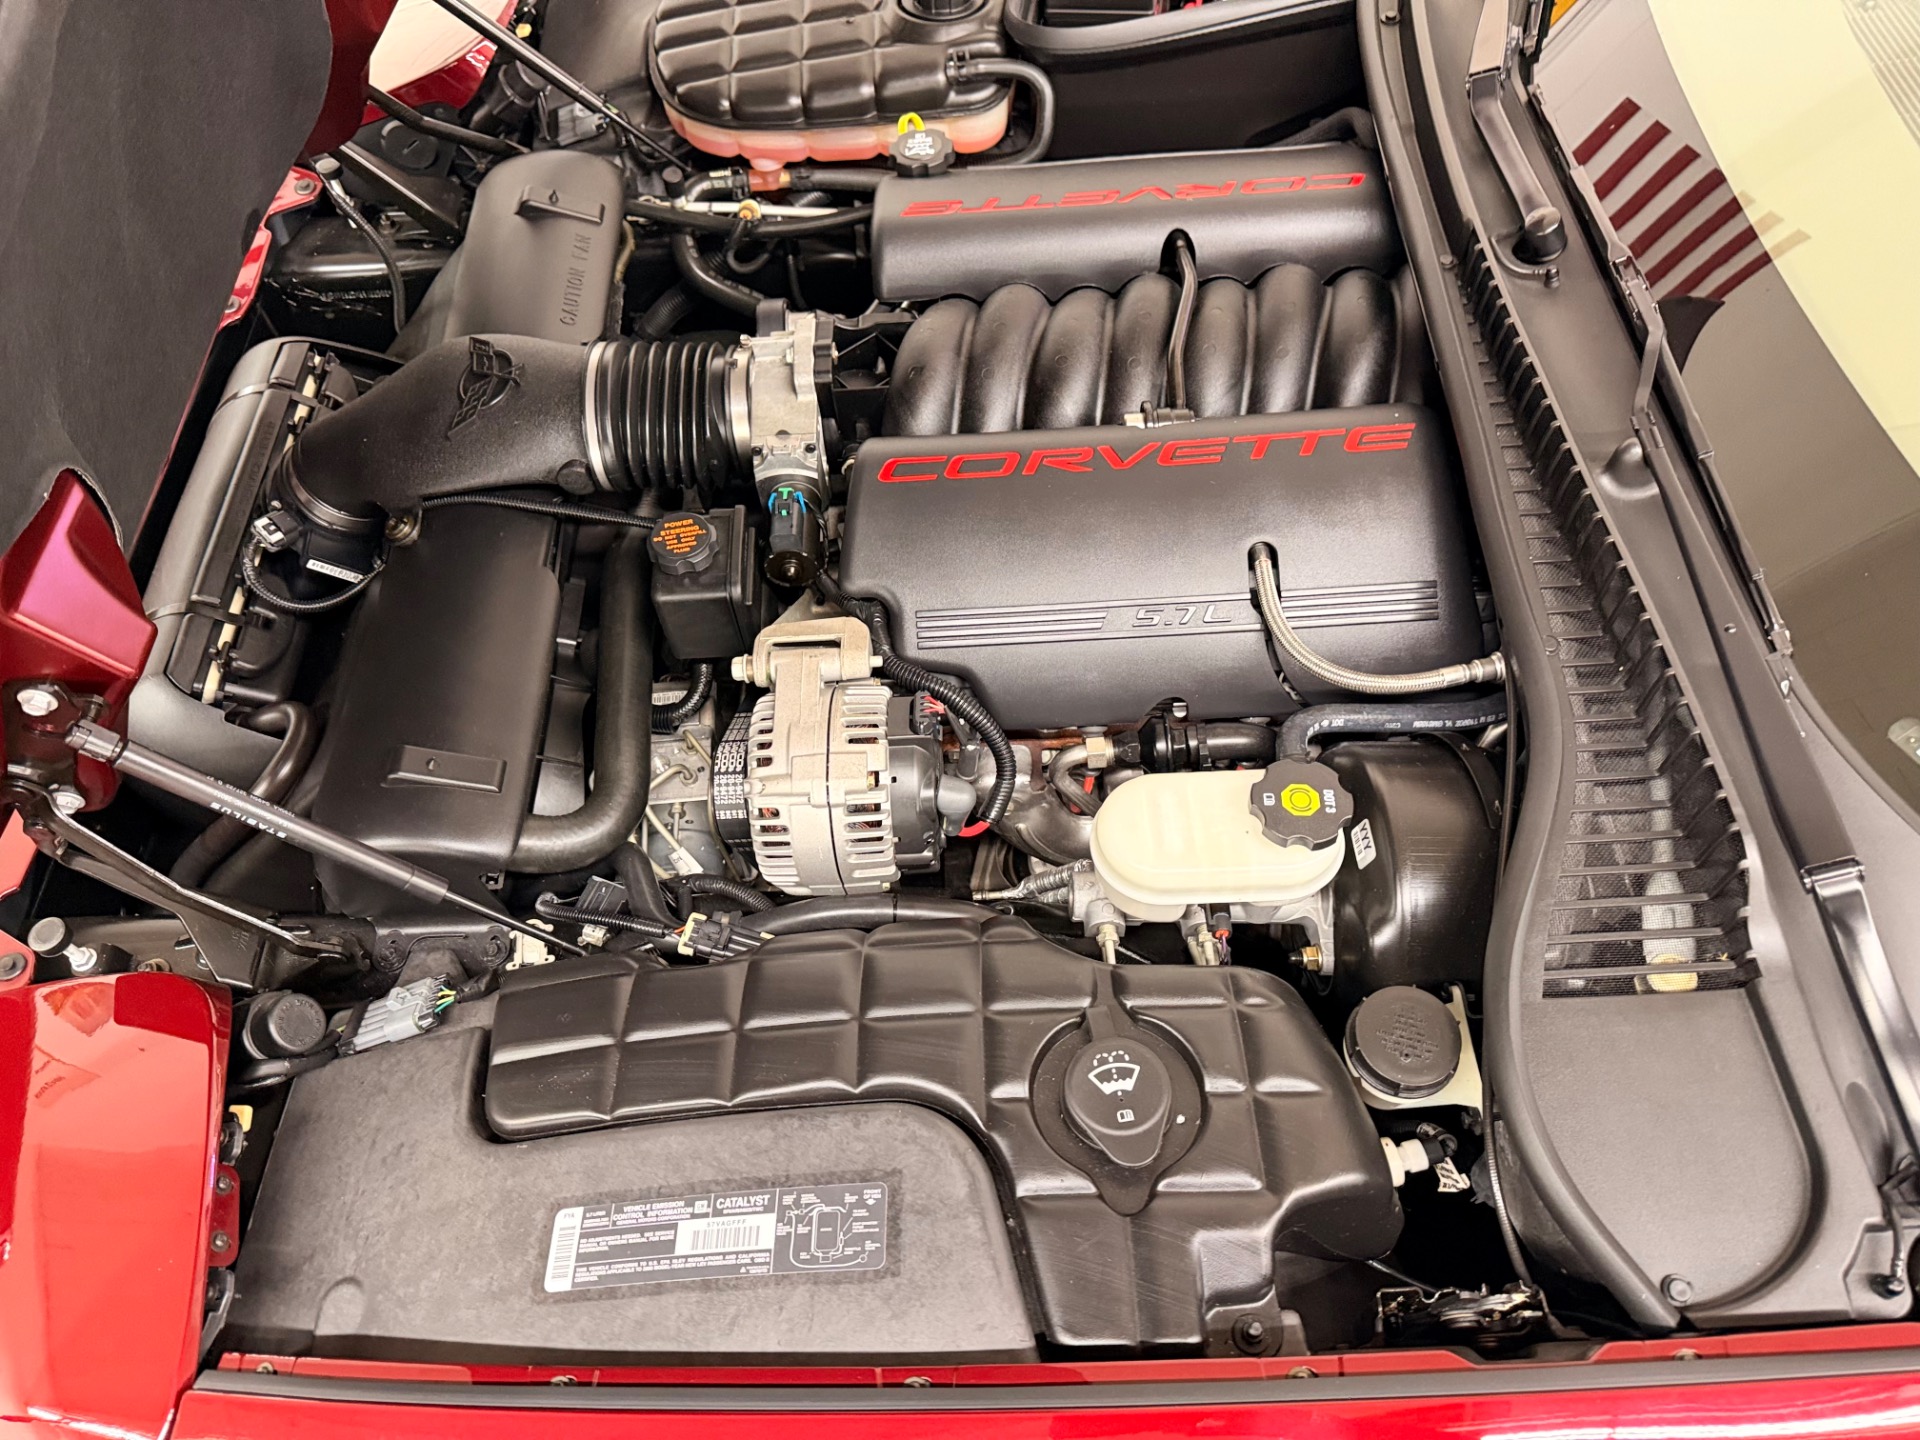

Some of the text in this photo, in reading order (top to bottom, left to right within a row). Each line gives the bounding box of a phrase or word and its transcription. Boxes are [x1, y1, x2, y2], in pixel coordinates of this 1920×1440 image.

[900, 173, 1366, 217] CORVETTE
[560, 233, 592, 327] CAUTION FAN
[878, 422, 1416, 483] CORVETTE
[660, 525, 700, 536] STEERING
[664, 518, 694, 528] POWER
[1132, 604, 1232, 629] 5.7L
[210, 802, 287, 838] STABILUS
[1360, 822, 1372, 850] YYY
[613, 1207, 693, 1220] CONTROL INFORMATION
[624, 1201, 685, 1212] VEHICLE EMISSION
[716, 1194, 770, 1209] CATALYST
